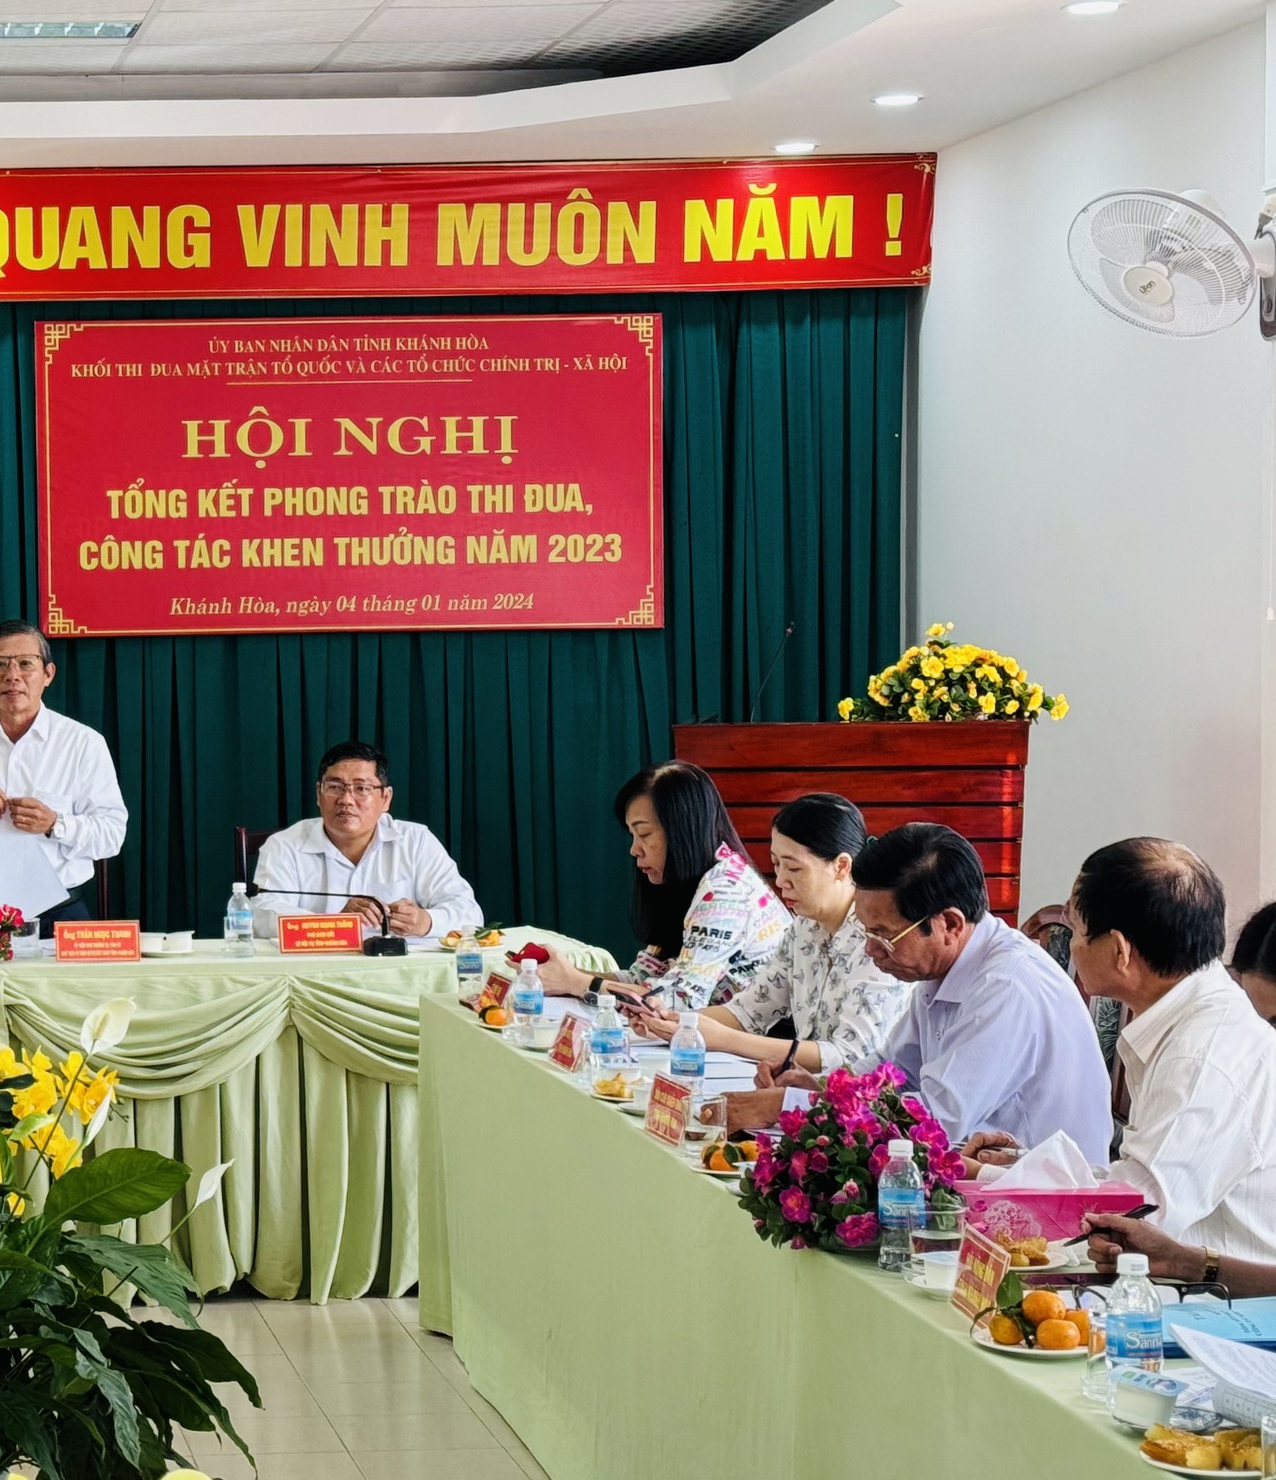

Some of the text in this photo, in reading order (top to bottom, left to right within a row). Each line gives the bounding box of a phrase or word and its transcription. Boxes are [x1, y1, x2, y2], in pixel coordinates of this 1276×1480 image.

[236, 203, 410, 267] VINH
[436, 188, 657, 266] MUÔN
[684, 183, 853, 263] NĂM
[885, 193, 904, 256] !
[208, 333, 489, 354] ỦY BAN NHÂN DÂN TỈNH KHÁNH HÒA
[71, 358, 111, 378] KHỐI
[115, 363, 143, 377] THI
[150, 363, 183, 377] ĐUA
[186, 360, 221, 379] MẶT
[225, 359, 268, 378] TRẬN
[271, 355, 294, 375] TỔ
[296, 354, 342, 377] QUỐC
[346, 358, 366, 374] VÀ
[370, 356, 403, 374] CÁC
[406, 353, 429, 374] TỔ
[431, 356, 476, 373] CHỨC
[479, 355, 530, 372] CHÍNH
[534, 357, 560, 375] TRỊ
[573, 354, 594, 371] XÃ
[598, 353, 628, 373] HỘI
[181, 406, 519, 468] HỘI NGHỊ
[106, 477, 593, 519] TỔNG KẾT PHONG TRÀO THI ĐUA,
[79, 526, 623, 571] CÔNG TÁC KHEN THƯỞNG NĂM 2023
[169, 593, 534, 617] Khánh Hòa, ngày 04 tháng 01 năm 2024
[691, 926, 733, 940] PARIS
